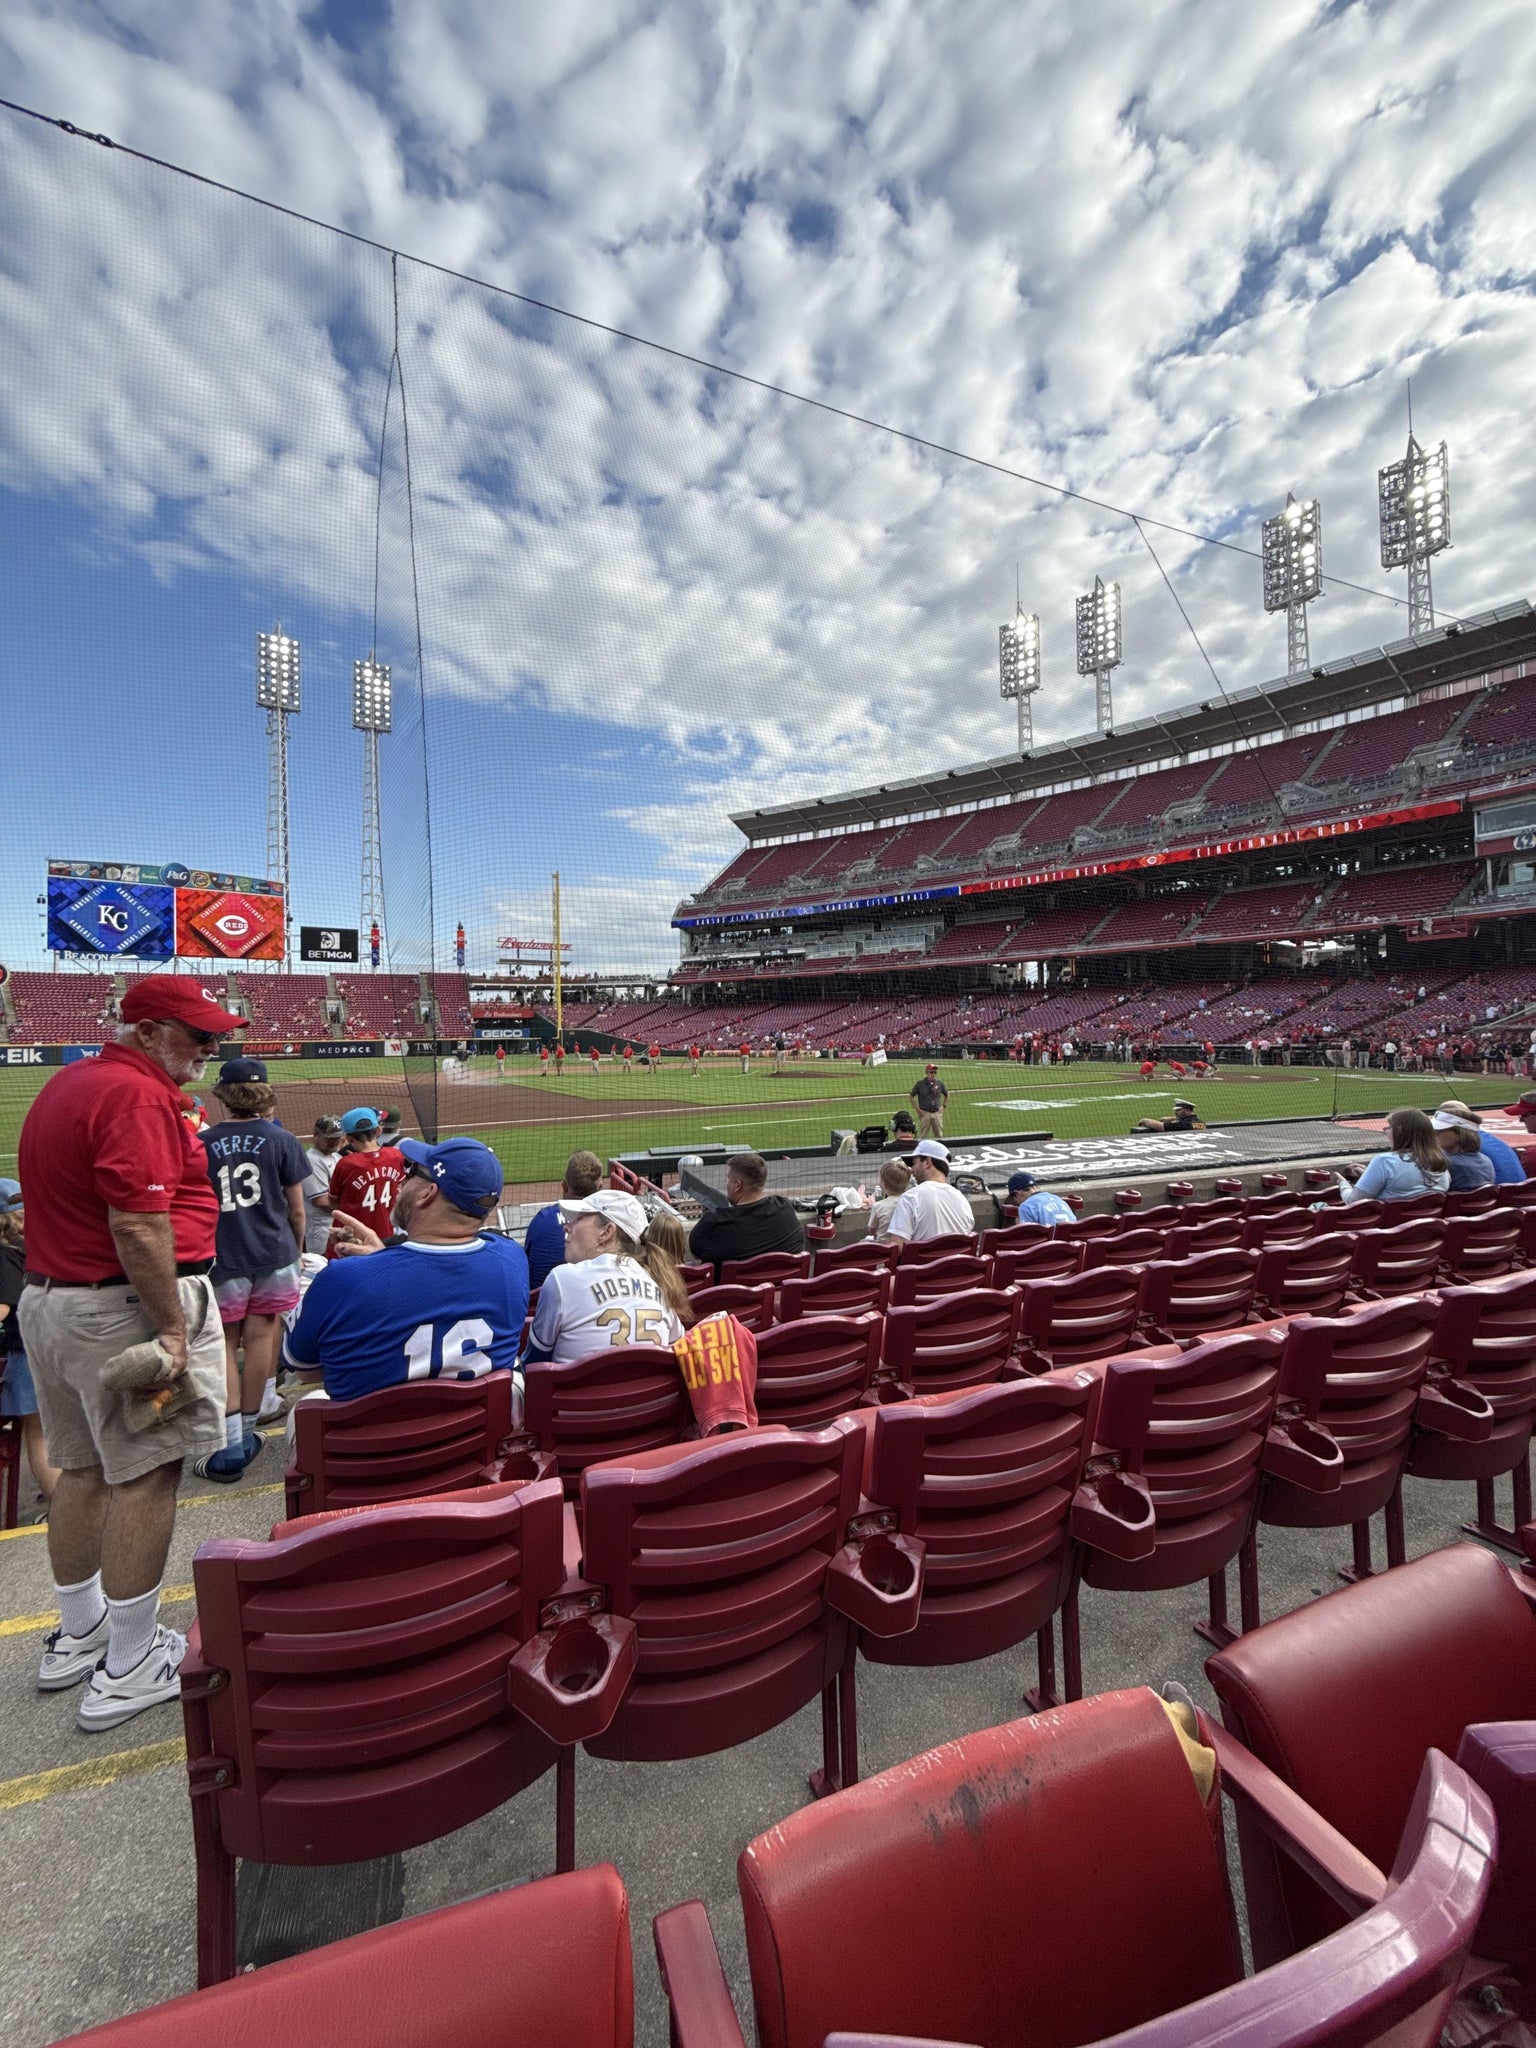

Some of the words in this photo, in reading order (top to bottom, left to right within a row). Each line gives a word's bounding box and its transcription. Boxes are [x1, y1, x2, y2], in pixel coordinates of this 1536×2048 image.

[1197, 830, 1300, 858] CINCINNATI
[1318, 818, 1363, 837] REDS
[167, 871, 188, 880] P&G
[990, 870, 1064, 890] CINCINNATI
[1075, 864, 1107, 877] REDS
[866, 898, 887, 907] CITY
[894, 892, 930, 904] ROYALS
[98, 904, 128, 931] KC
[64, 950, 108, 961] BEACON
[308, 950, 352, 960] BETMGM
[482, 1029, 523, 1038] GEICO
[318, 1046, 371, 1054] MEDPACE
[210, 1135, 266, 1159] PEREZ
[1043, 1131, 1234, 1152] COUNTRY
[217, 1162, 261, 1213] 13
[352, 1175, 367, 1190] DE
[366, 1167, 380, 1181] LA
[381, 1166, 400, 1182] CRUZ
[362, 1181, 392, 1212] 44
[590, 1277, 662, 1306] HOSMER
[597, 1308, 663, 1346] 35
[404, 1318, 494, 1381] 16
